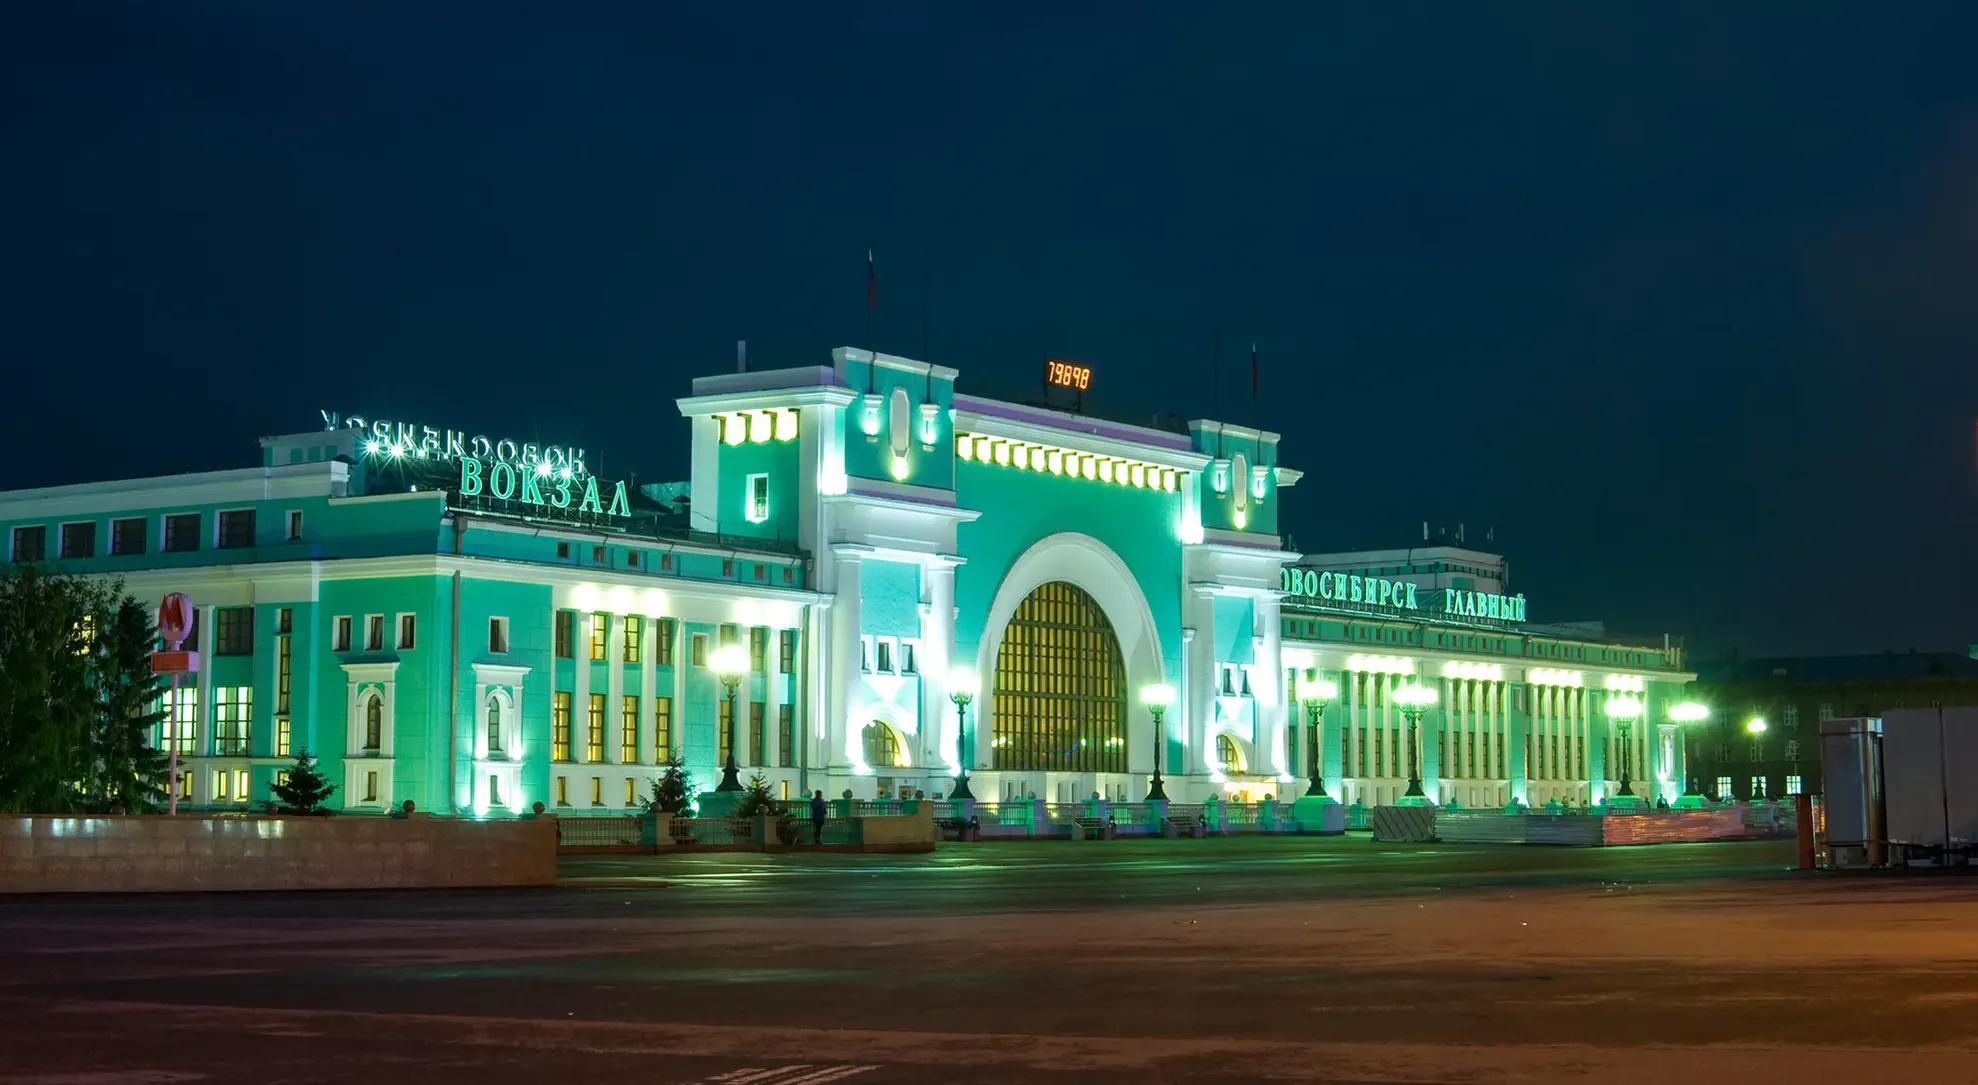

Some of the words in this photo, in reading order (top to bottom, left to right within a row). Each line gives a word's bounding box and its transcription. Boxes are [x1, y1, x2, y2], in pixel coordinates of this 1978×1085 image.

[460, 456, 631, 517] ВОКЗАЛ
[1280, 567, 1418, 609] ОВОСИБИРСК
[1445, 588, 1526, 622] ГЛАВНЫЙ
